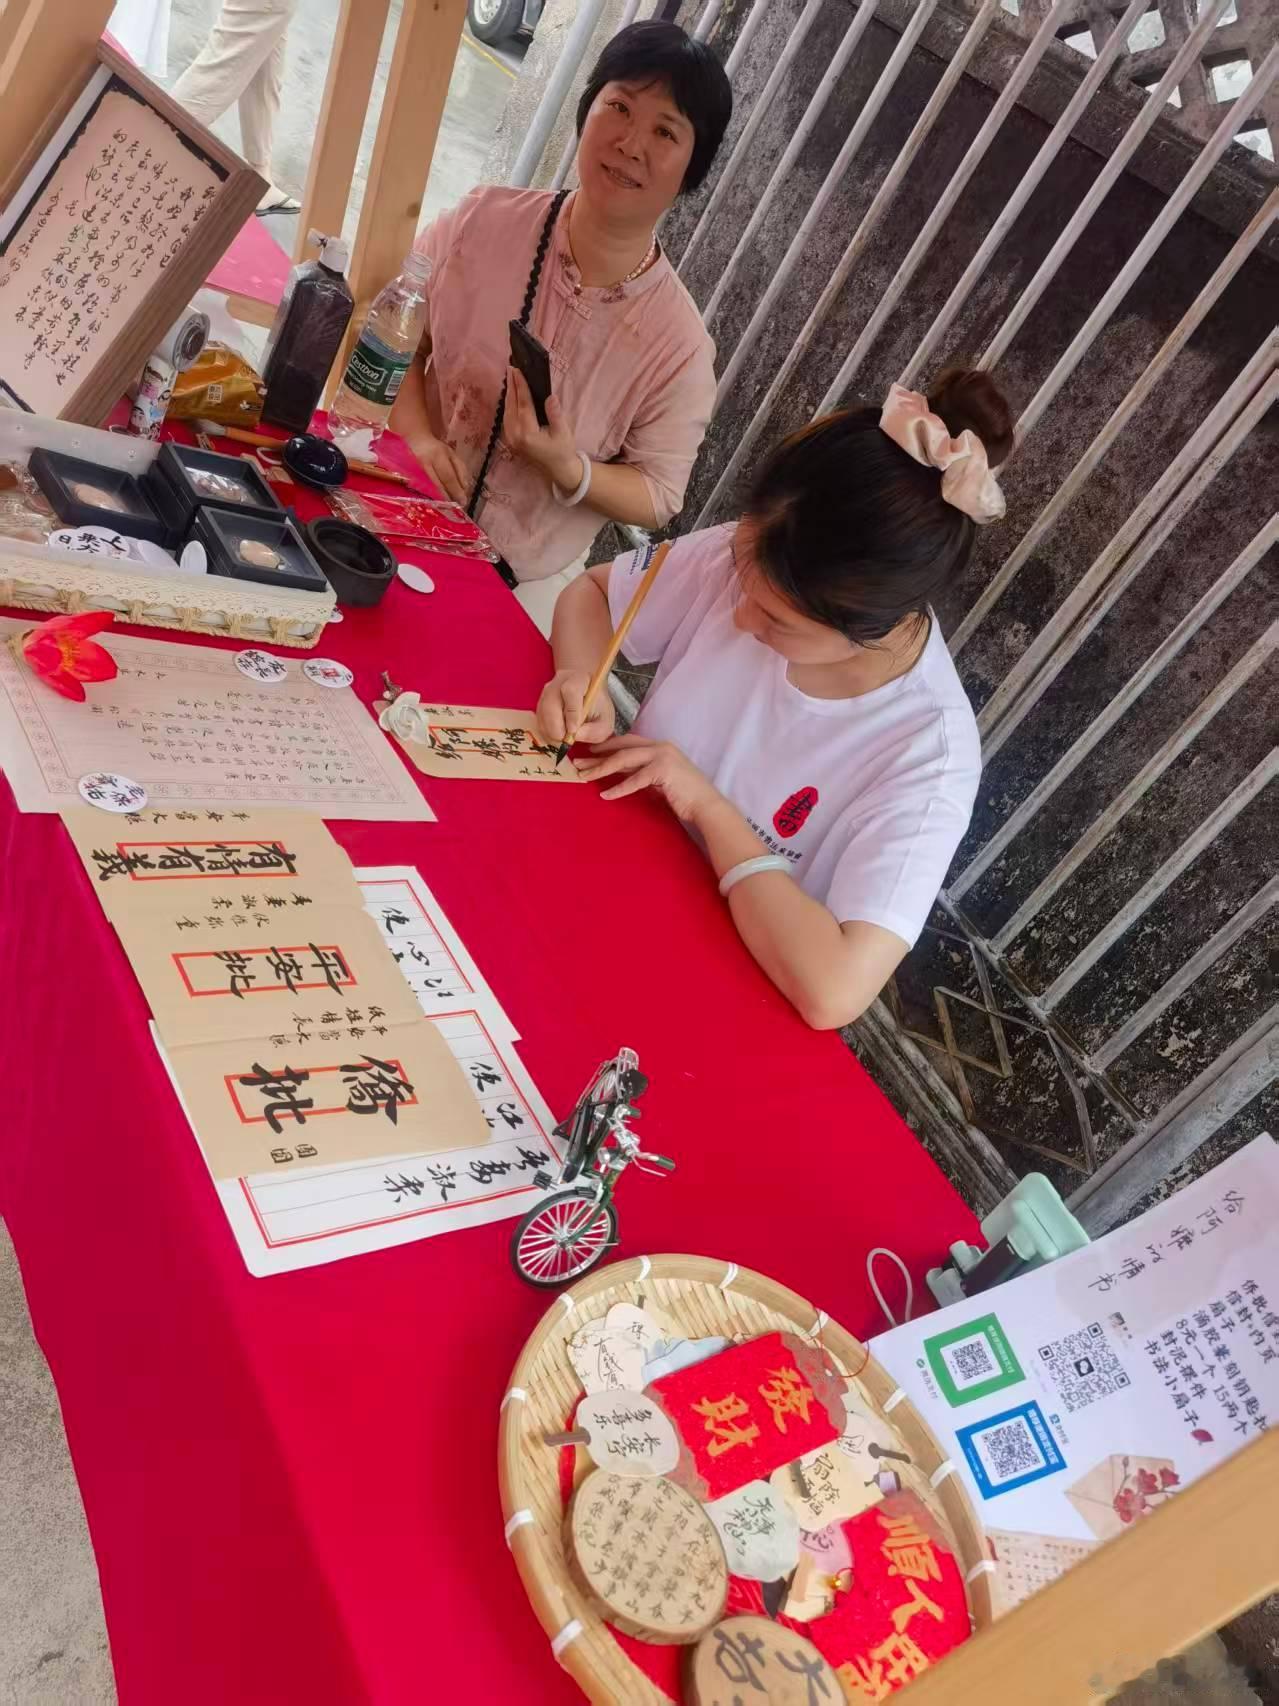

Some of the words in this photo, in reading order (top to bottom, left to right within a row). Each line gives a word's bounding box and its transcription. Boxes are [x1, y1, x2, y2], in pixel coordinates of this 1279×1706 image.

[91, 841, 298, 882] 有情有義
[213, 942, 351, 1000] 平安批
[239, 1053, 416, 1136] 僑批
[1208, 1301, 1236, 1334] 扇子
[1145, 1340, 1199, 1430] 书法小扇子
[1160, 1330, 1206, 1402] 封泥摆件
[1176, 1318, 1217, 1378] 8元一个
[1212, 1385, 1250, 1438] 15两个
[603, 1430, 656, 1459] 长安宁
[691, 1364, 816, 1461] 發財
